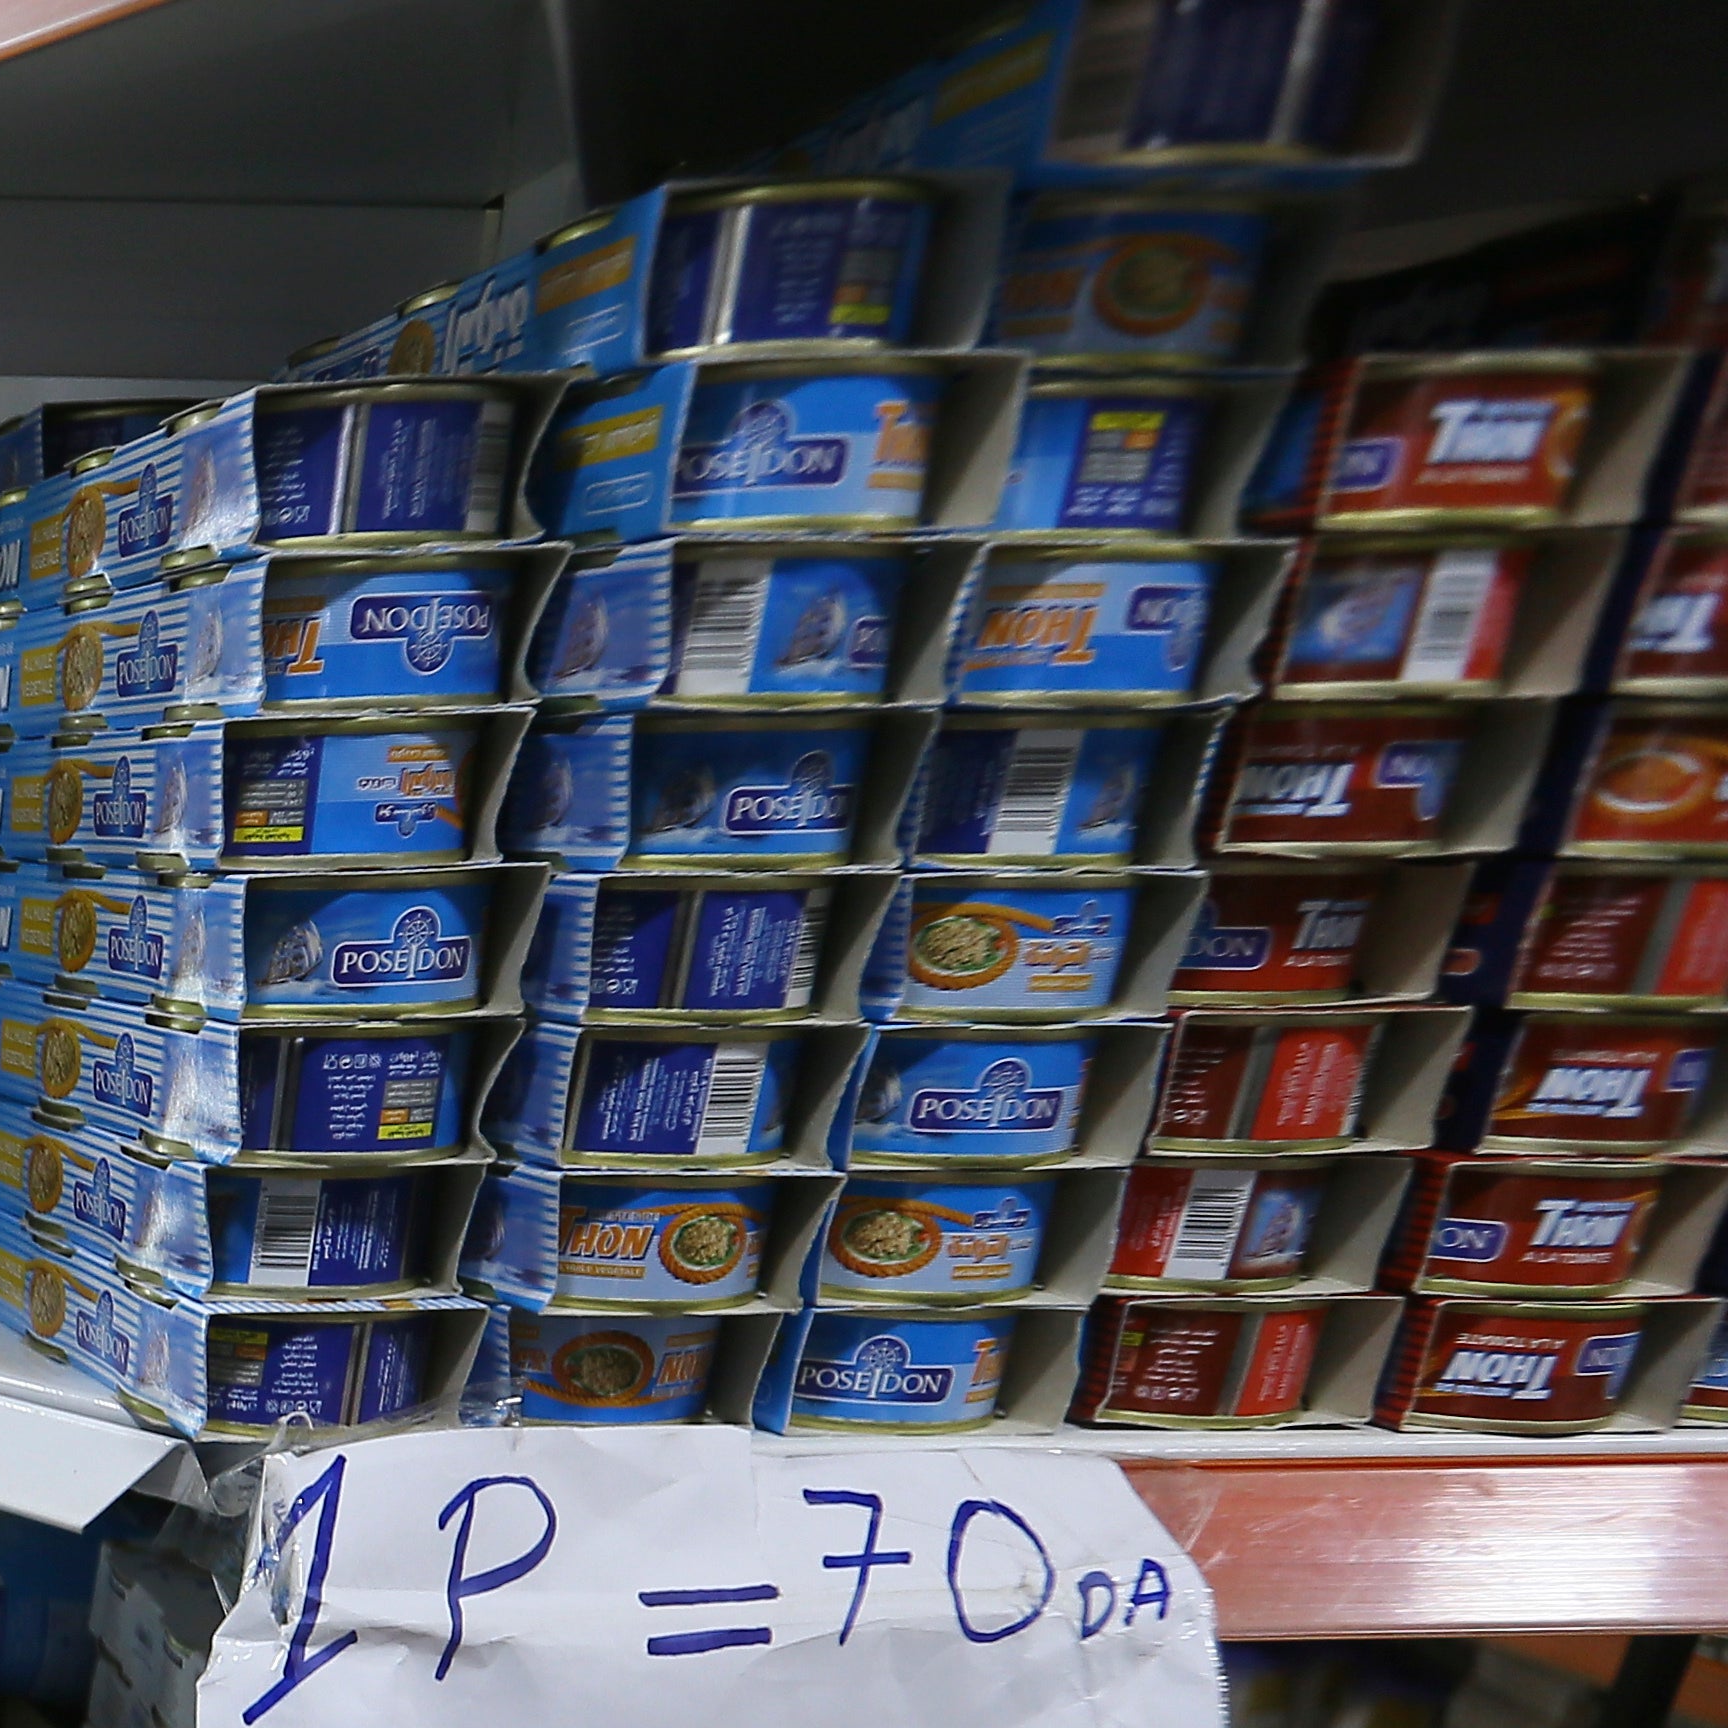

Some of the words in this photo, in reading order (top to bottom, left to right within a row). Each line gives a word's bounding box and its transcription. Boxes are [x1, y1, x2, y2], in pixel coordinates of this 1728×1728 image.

[121, 502, 171, 543] POSEIDON
[363, 598, 490, 641] POSEIDON
[981, 606, 1099, 663] THON
[119, 653, 174, 690] POSEIDON
[95, 801, 145, 833] POSEIDON
[110, 935, 164, 970] POSEIDON
[341, 944, 464, 979] POSEIDON
[96, 1066, 152, 1106] POSEIDON
[920, 1092, 1057, 1130] POSEIDON
[75, 1189, 127, 1239] POSEIDON
[559, 1206, 654, 1259] THON
[1529, 1200, 1630, 1248] THON
[79, 1318, 130, 1370] POSEIDON
[799, 1362, 944, 1400] POSEIDON
[1440, 1350, 1558, 1400] THON
[802, 1489, 1057, 1647] 70
[1077, 1558, 1174, 1640] DA
